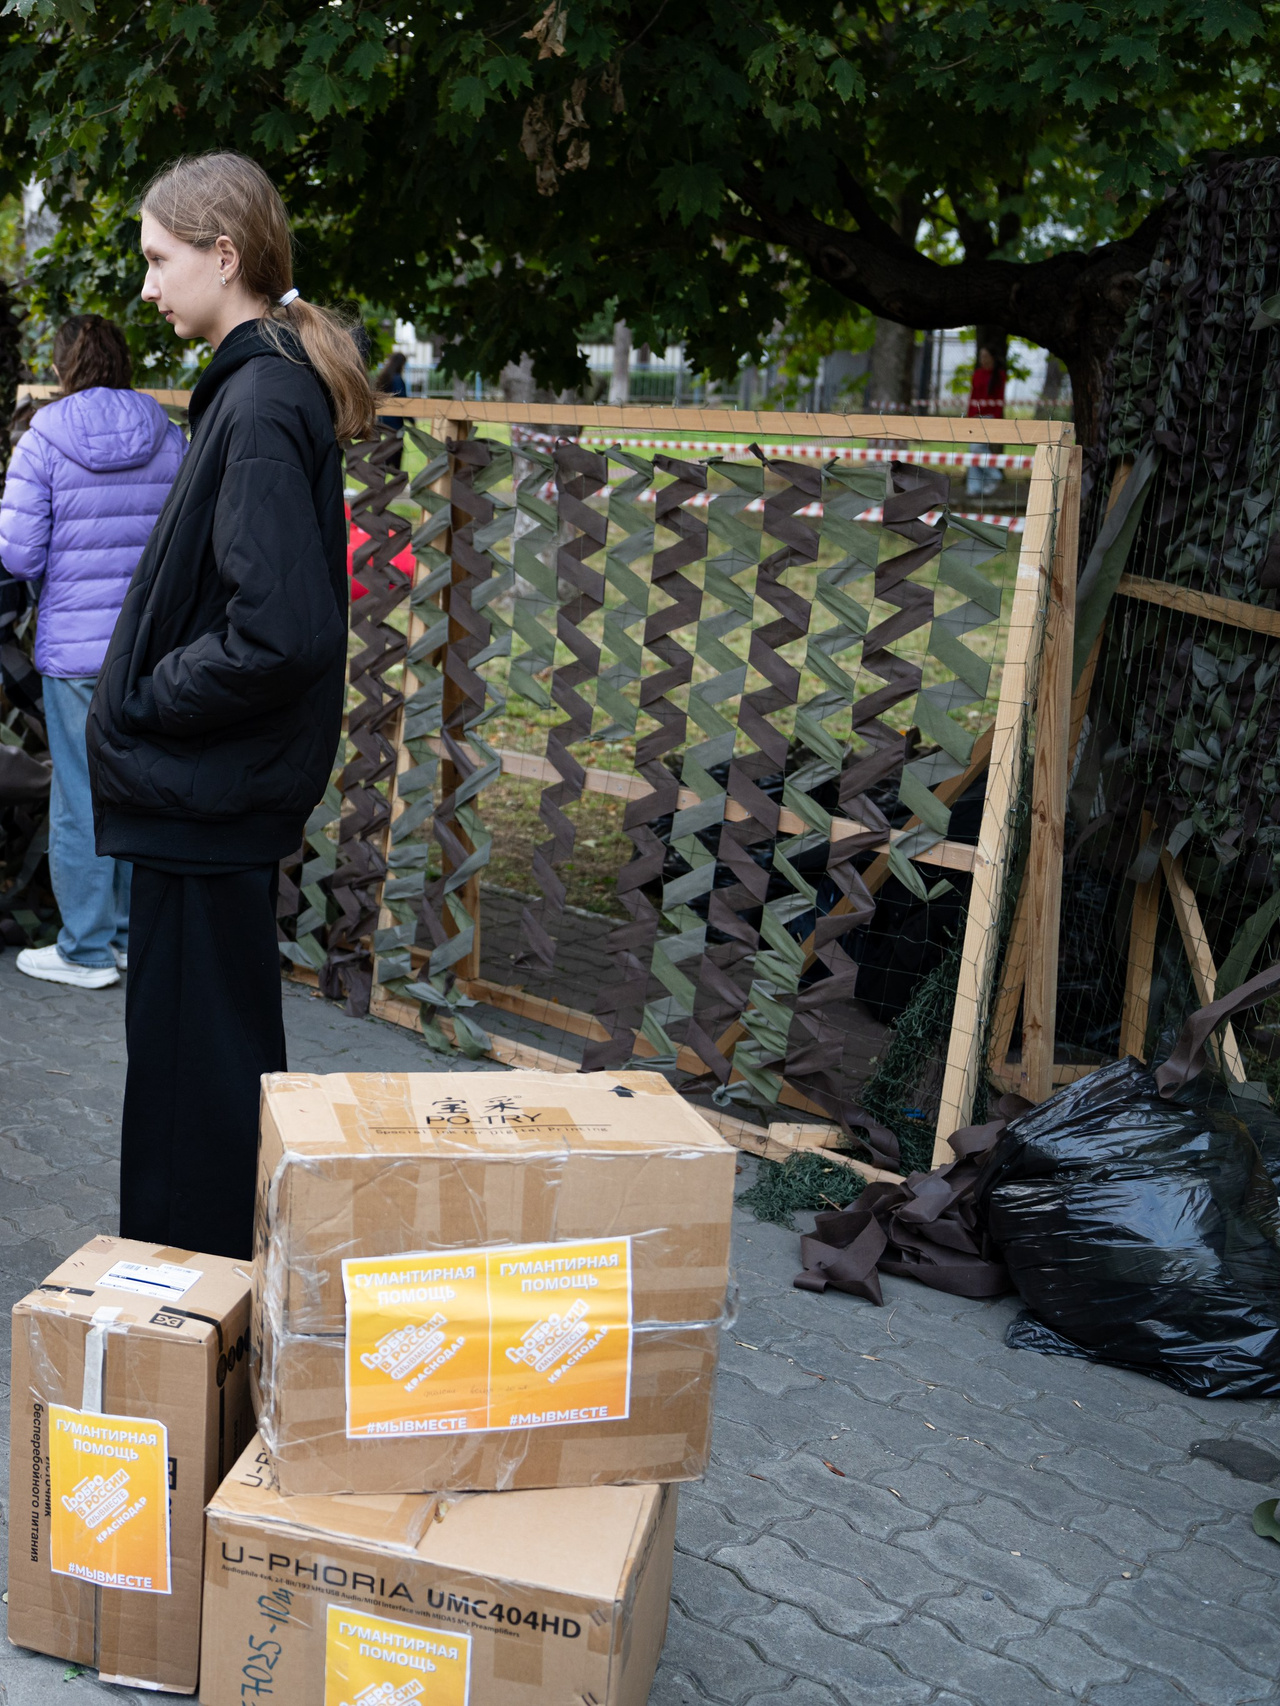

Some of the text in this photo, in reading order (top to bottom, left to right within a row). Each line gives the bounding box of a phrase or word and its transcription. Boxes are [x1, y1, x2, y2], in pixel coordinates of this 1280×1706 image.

[426, 1113, 542, 1125] PO-TRY
[355, 1266, 476, 1288] ГУМАНТИРНАЯ
[499, 1254, 619, 1276] ГУМАНТИРНАЯ
[521, 1274, 598, 1293] ПОМОЩЬ
[378, 1286, 456, 1306] ПОМОЩЬ
[360, 1324, 415, 1370] ДОБРО
[391, 1314, 444, 1362] РОССИИ
[505, 1313, 560, 1364] ДОБРО
[535, 1302, 586, 1354] РОССИИ
[404, 1336, 466, 1393] КРАСНОДАР
[547, 1325, 608, 1384] КРАСНОДАР
[56, 1419, 158, 1446] ГУМАНТИРНАЯ
[366, 1417, 467, 1434] #МЫВМЕСТЕ
[509, 1406, 609, 1426] #МЫВМЕСТЕ
[73, 1439, 139, 1462] ПОМОЩЬ
[30, 1403, 44, 1562] бесперебойного питания
[61, 1474, 104, 1513] ДОБРО
[77, 1471, 128, 1518] В РОССИИ
[96, 1496, 147, 1544] КРАСНОДАР
[68, 1562, 153, 1589] #МЫВМЕСТЕ
[221, 1541, 581, 1639] U-PHORIA UMC404HD
[222, 1564, 258, 1578] Audiophile
[325, 1588, 340, 1597] USB
[341, 1592, 381, 1606] Audio/MIDI
[382, 1602, 414, 1614] Interface
[415, 1609, 431, 1618] with
[432, 1613, 456, 1624] MIDAS
[471, 1621, 520, 1638] Preamplifiers
[339, 1622, 459, 1661] ГУМАНТИРНАЯ
[359, 1643, 437, 1673] ПОМОЩЬ
